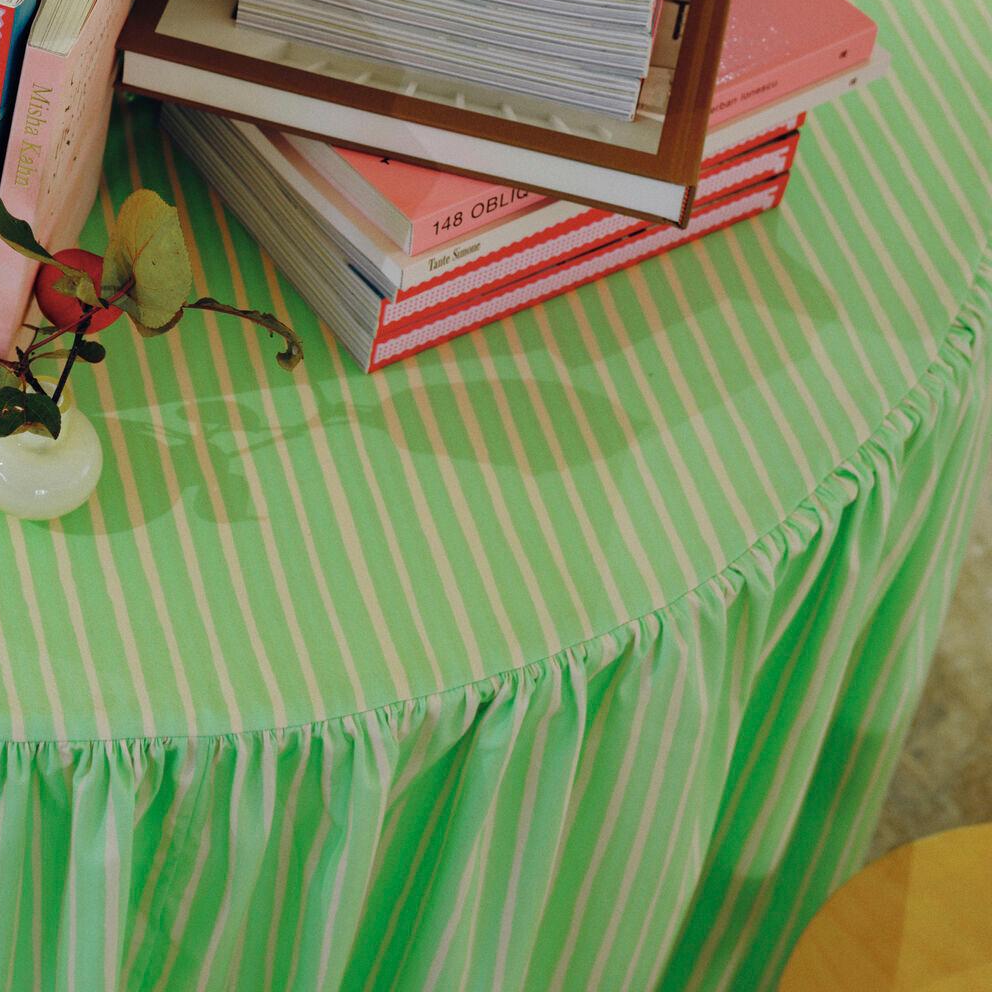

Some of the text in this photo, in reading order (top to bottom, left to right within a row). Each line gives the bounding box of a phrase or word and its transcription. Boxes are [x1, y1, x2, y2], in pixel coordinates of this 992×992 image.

[14, 81, 54, 187] Misha Kahn
[433, 212, 463, 235] 148
[428, 241, 481, 272] Tante Simone
